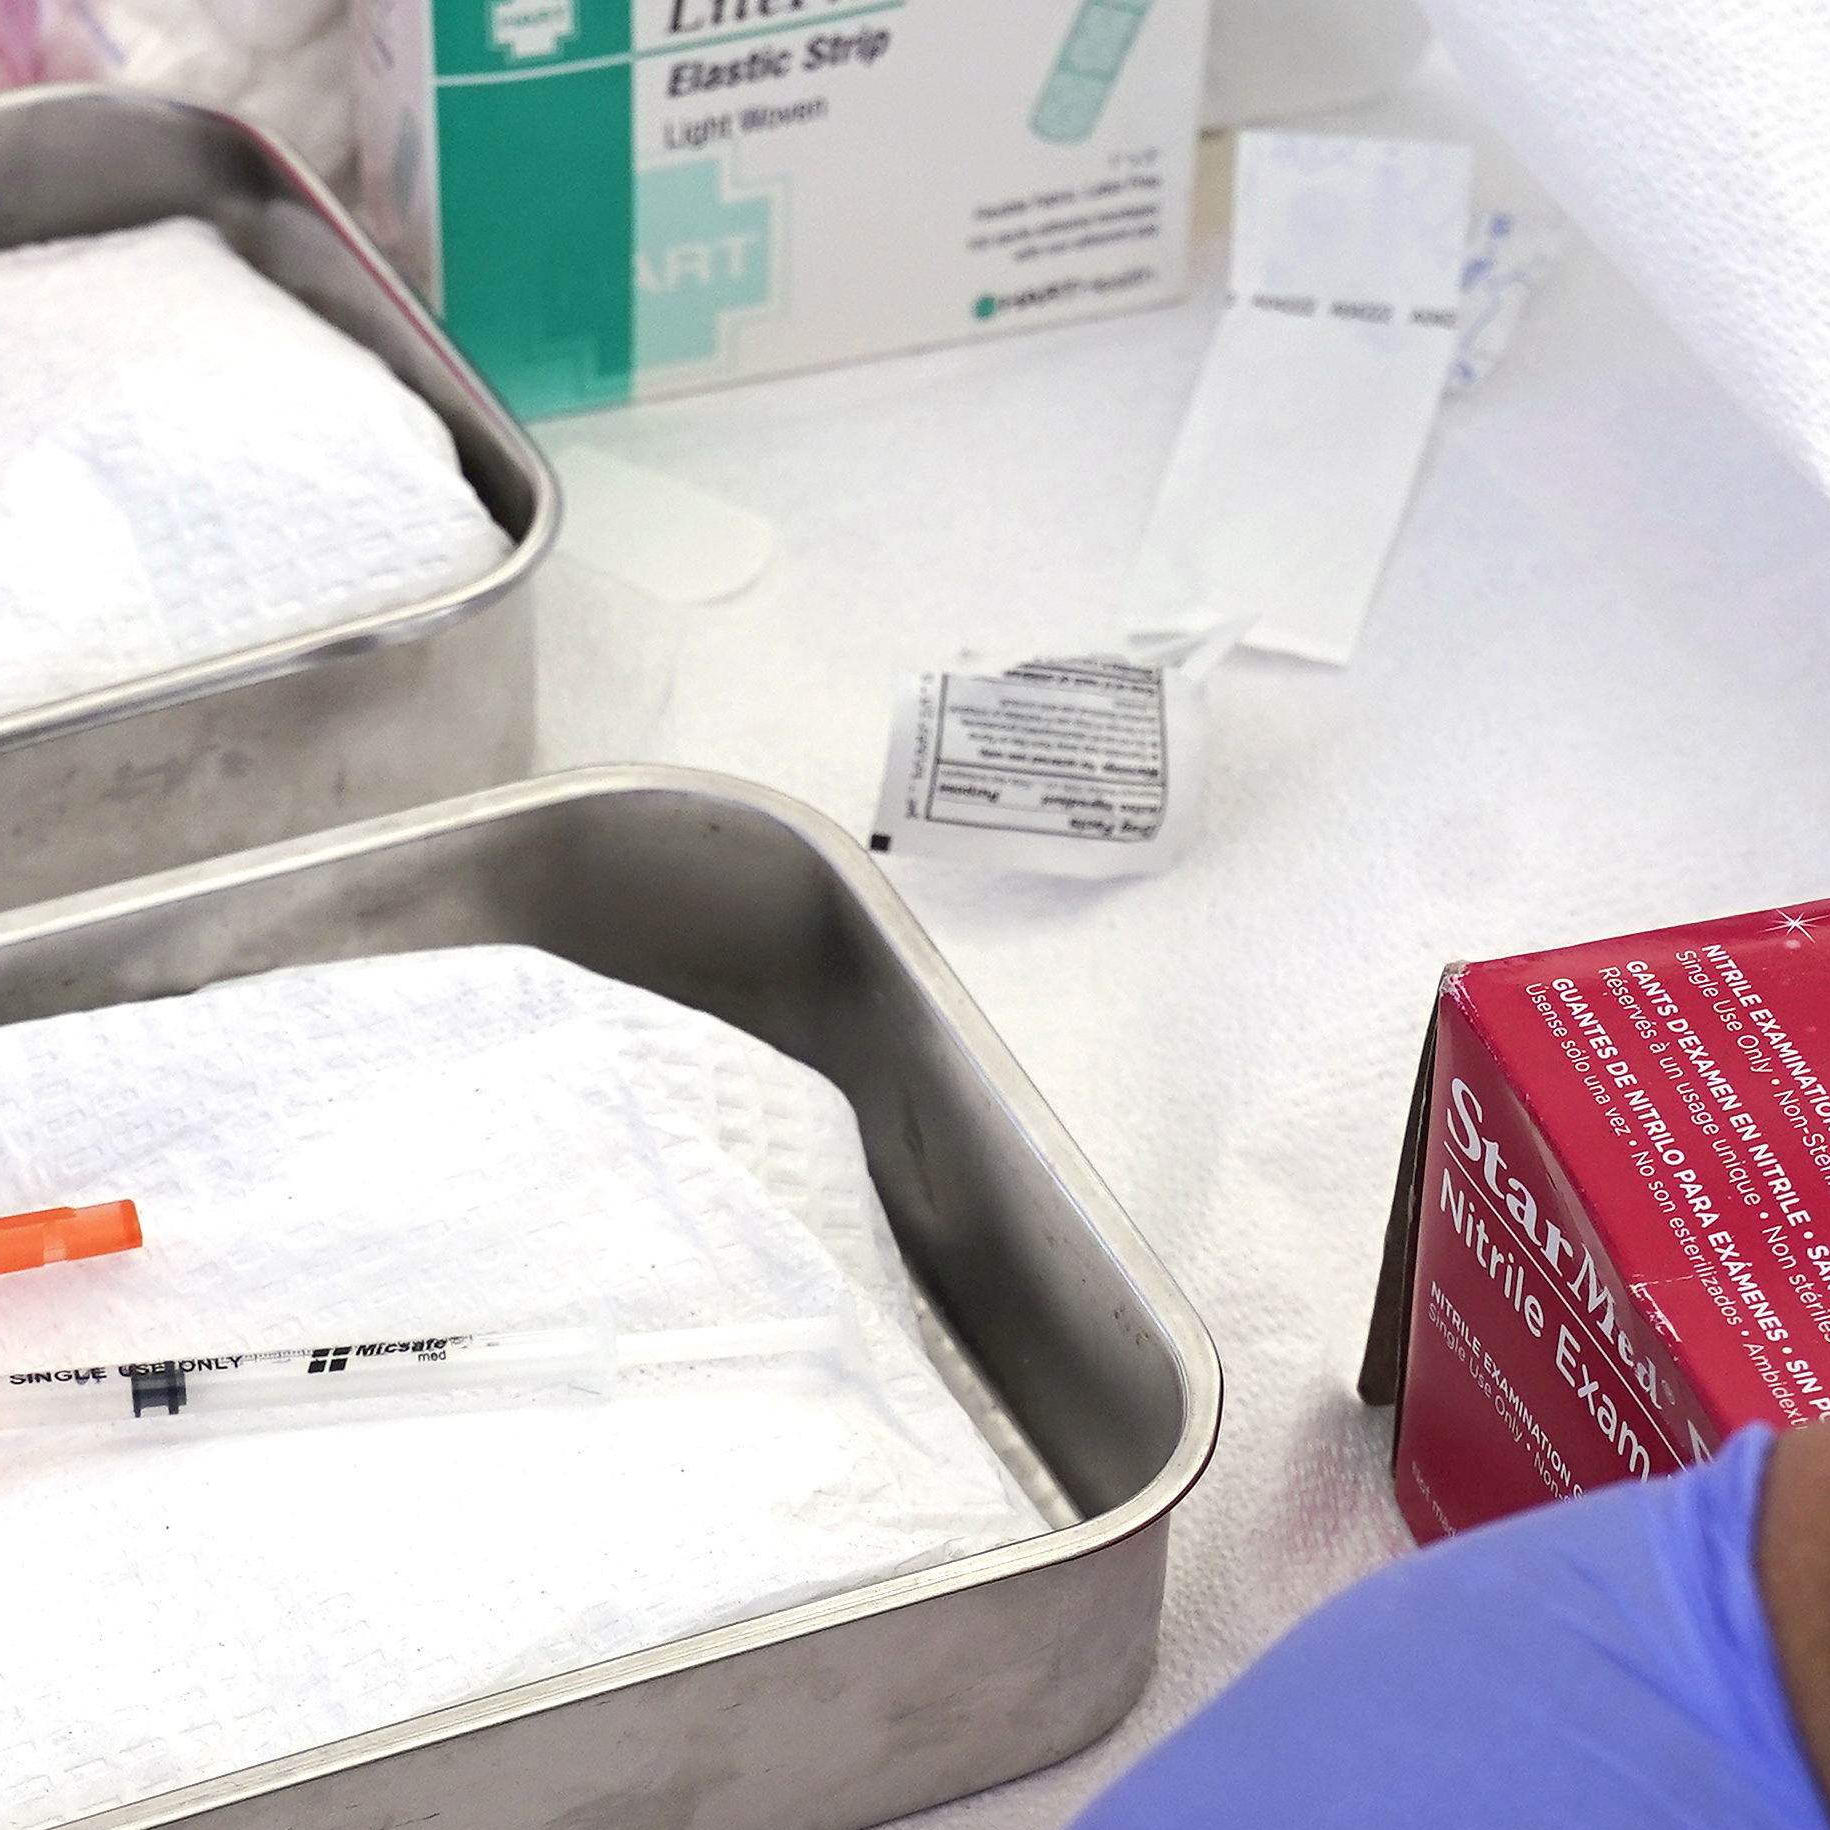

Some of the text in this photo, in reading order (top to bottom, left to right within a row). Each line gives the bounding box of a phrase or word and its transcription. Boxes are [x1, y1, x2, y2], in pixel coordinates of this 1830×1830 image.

[663, 23, 892, 99] Elastic Strip
[663, 98, 829, 151] Light Woven
[1597, 966, 1658, 1039] Réservés
[1675, 950, 1719, 998] Single
[1712, 999, 1743, 1032] Use
[1736, 1034, 1774, 1073] Only
[1701, 944, 1763, 1008] NITRILE
[1649, 1041, 1671, 1054] à
[1659, 1056, 1684, 1080] un
[1625, 960, 1679, 1017] GANTS
[1666, 1018, 1743, 1111] D'EXAMEN
[1729, 1112, 1762, 1142] EN
[1748, 1143, 1812, 1227] NITRILE
[1676, 1082, 1720, 1135] usage
[1525, 982, 1568, 1038] Úsense
[1560, 1039, 1591, 1073] sólo
[1583, 1074, 1611, 1105] una
[1604, 1106, 1632, 1137] vez
[1630, 1150, 1655, 1177] No
[1648, 1180, 1676, 1213] son
[1669, 1217, 1743, 1326] esterilizados
[1552, 978, 1619, 1059] GUANTES
[1605, 1061, 1638, 1089] DE
[1624, 1089, 1685, 1166] NITRILO
[1672, 1168, 1721, 1228] PARA
[1707, 1230, 1789, 1342] EXÁMENES
[1785, 1359, 1823, 1394] SIN
[1712, 1138, 1761, 1206] unique
[1761, 1225, 1797, 1270] Non
[1440, 1167, 1652, 1500] Nitrile Exam
[7, 1354, 246, 1388] SINGLE USE ONLY
[1428, 1302, 1466, 1362] Single
[1468, 1356, 1492, 1399] Use
[1494, 1394, 1523, 1443] Only
[1430, 1280, 1482, 1359] NITRILE
[1483, 1351, 1571, 1488] EXAMINATION
